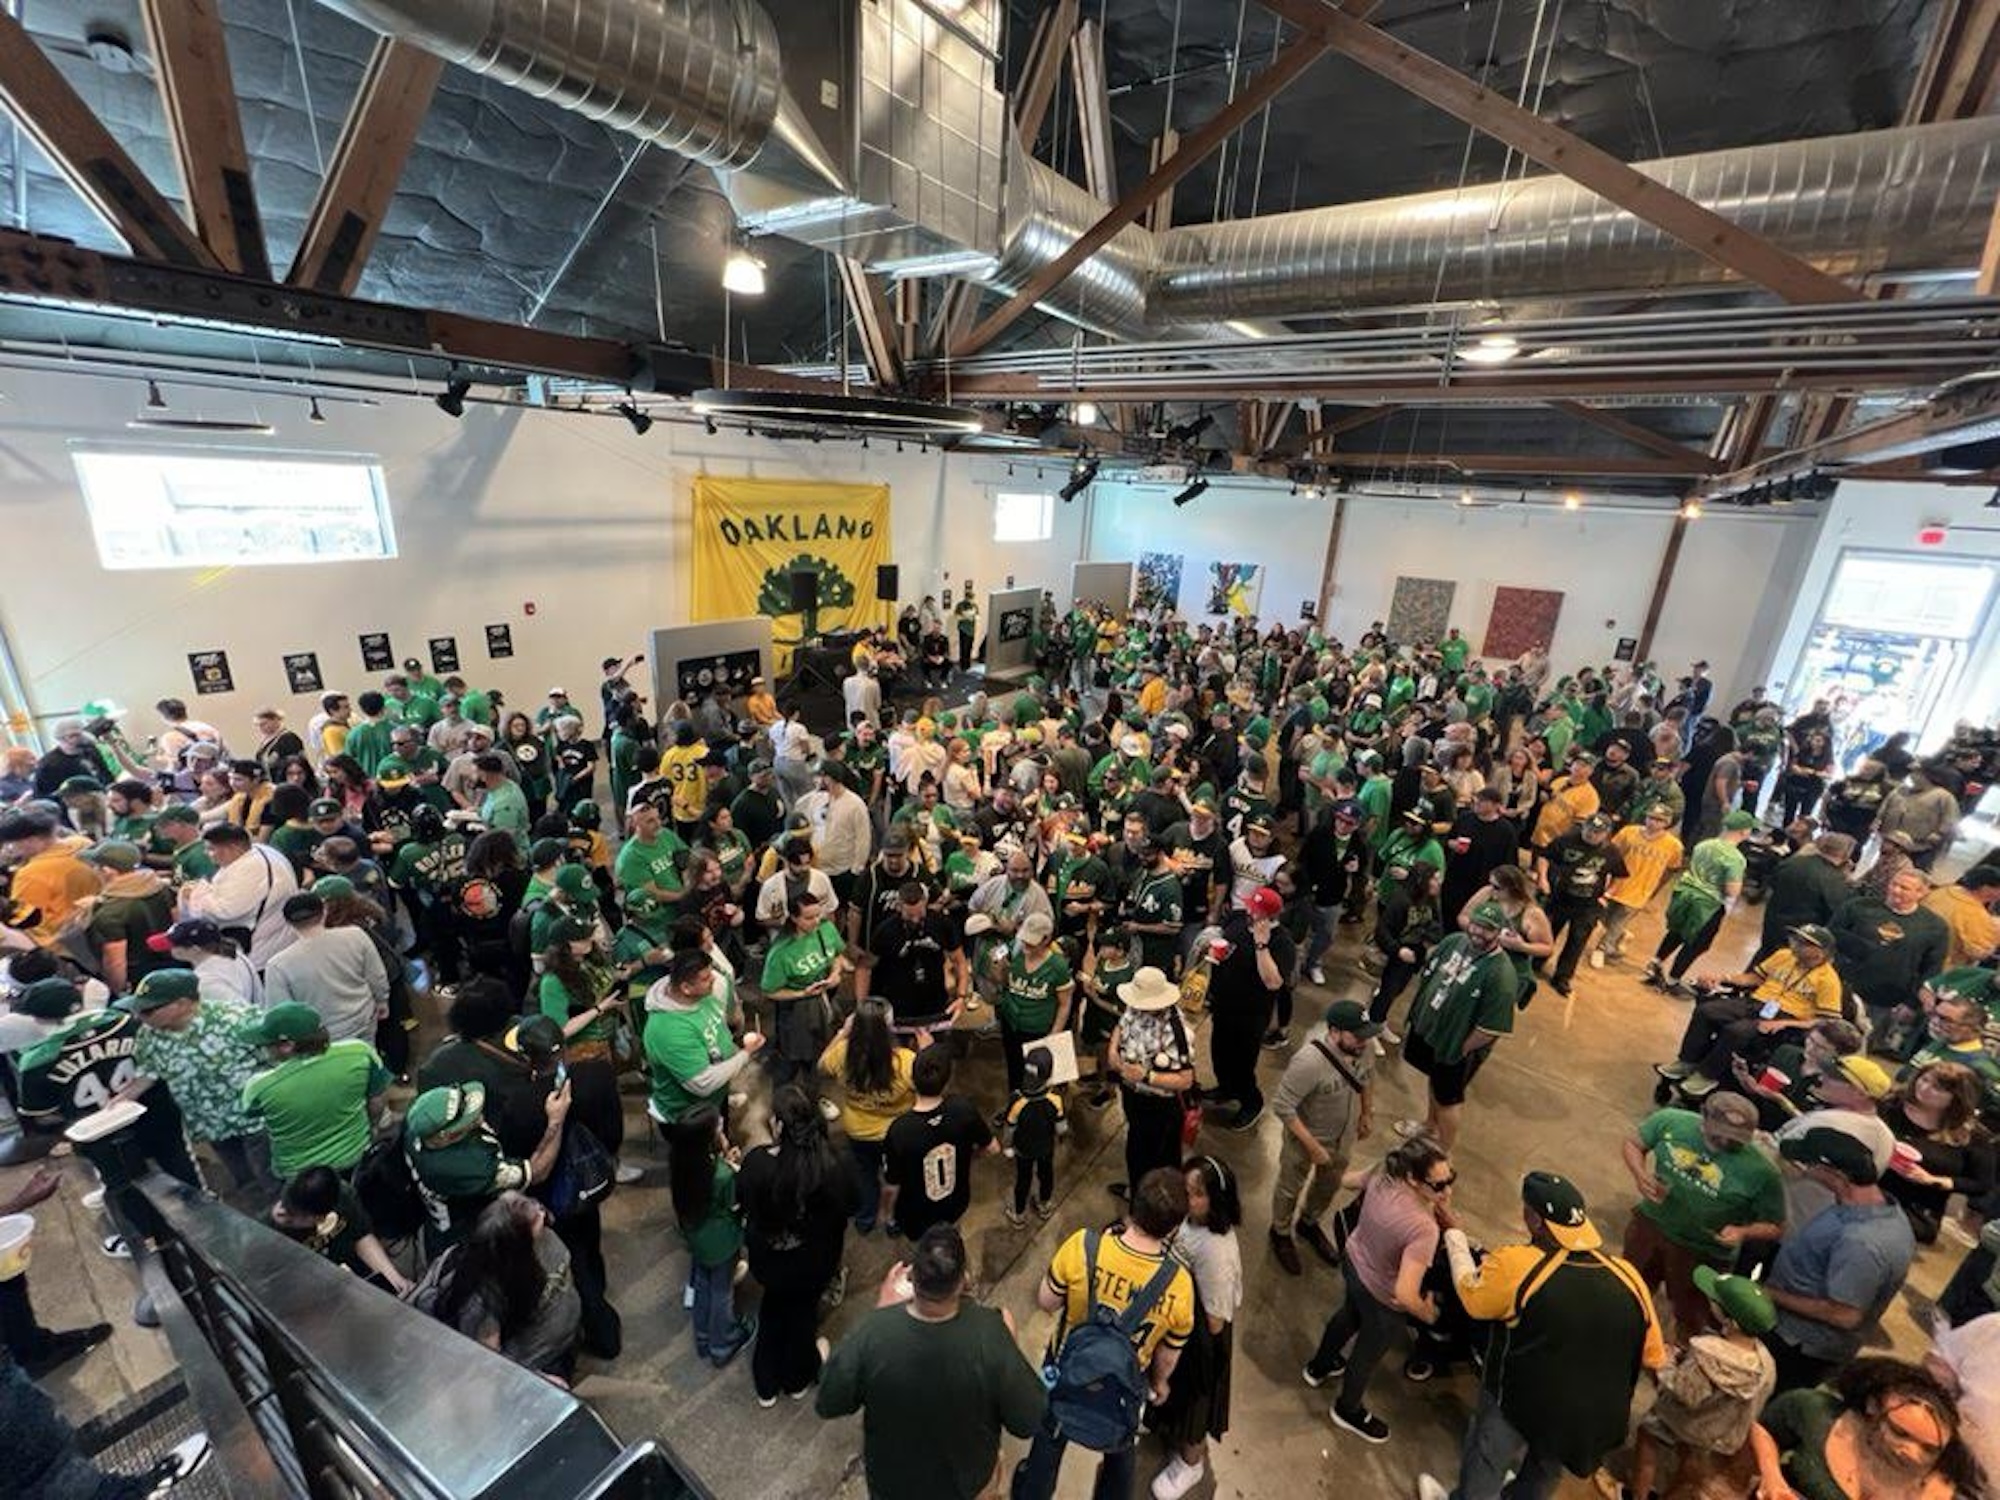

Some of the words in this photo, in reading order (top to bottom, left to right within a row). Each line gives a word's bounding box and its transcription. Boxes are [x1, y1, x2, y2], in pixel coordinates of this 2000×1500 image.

[720, 513, 874, 547] OAKLAND
[672, 763, 699, 781] 33
[46, 1037, 137, 1084] LUZARD
[73, 1057, 137, 1109] 44
[923, 1142, 957, 1202] 0
